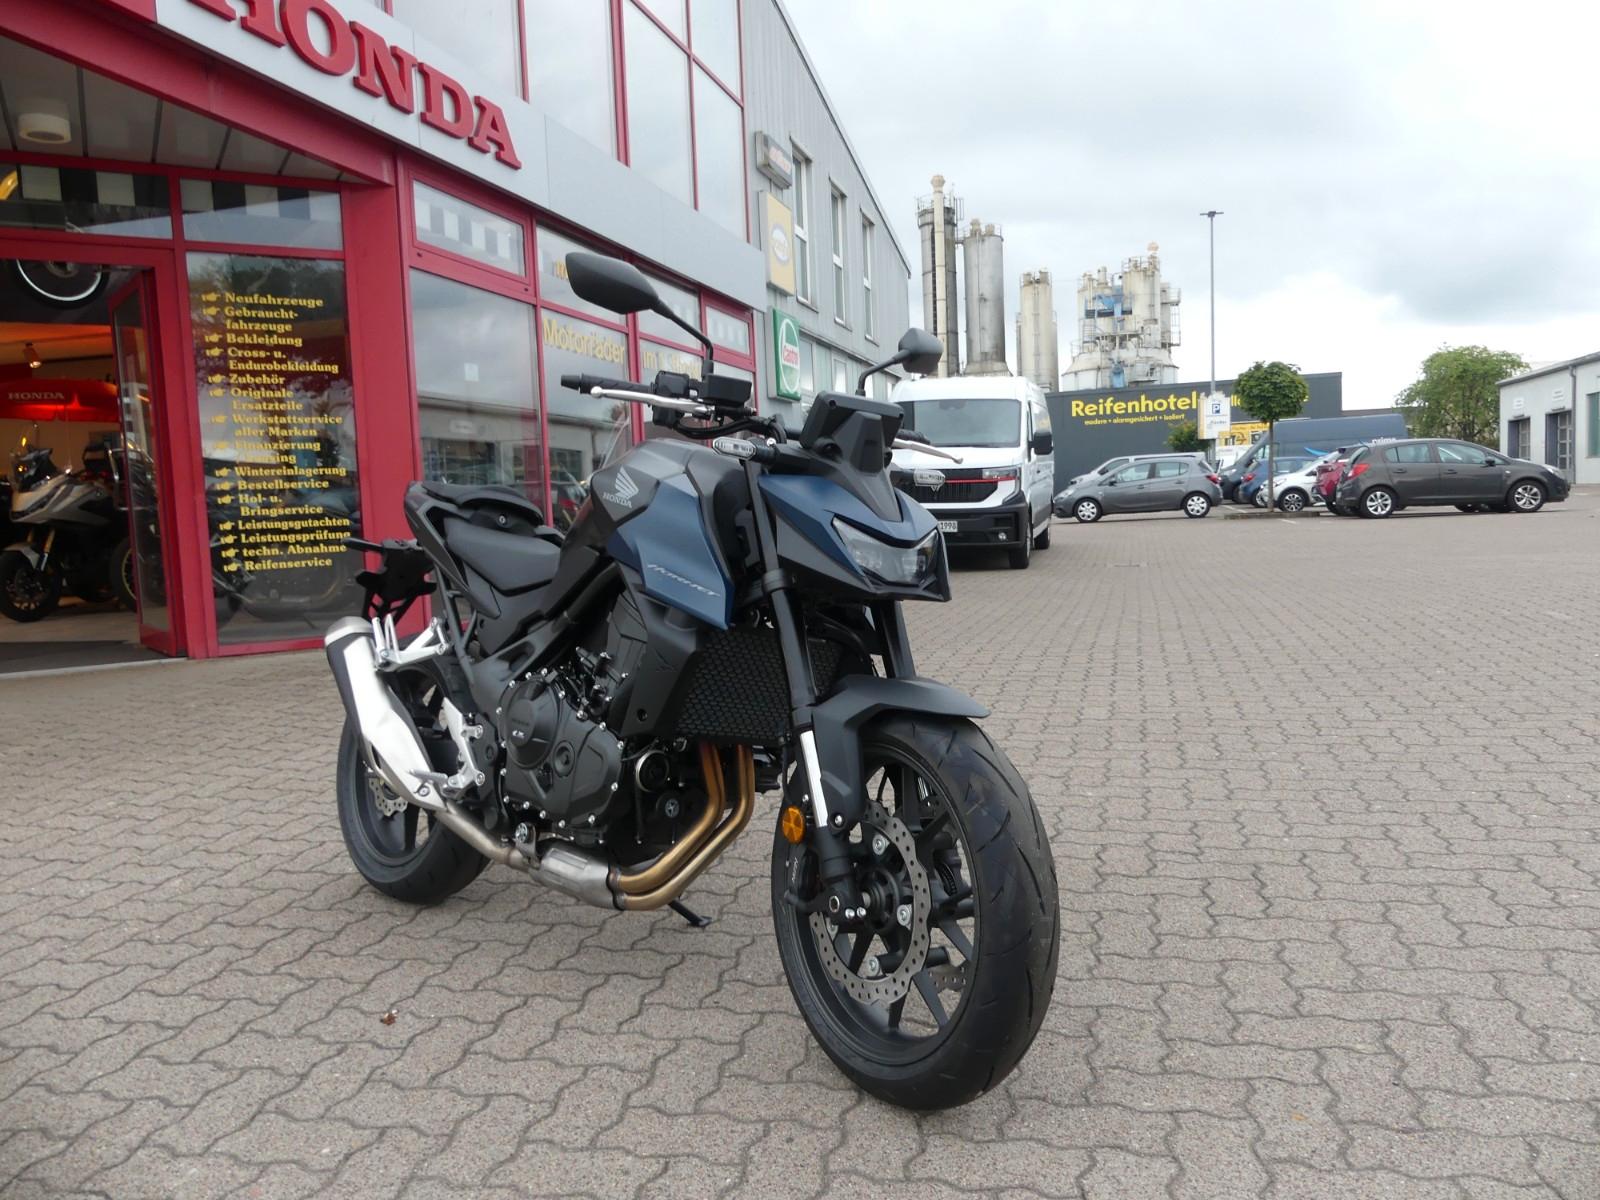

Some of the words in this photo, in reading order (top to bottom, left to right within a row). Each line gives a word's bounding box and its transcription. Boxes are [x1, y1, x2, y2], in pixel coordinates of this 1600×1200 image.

[224, 292, 324, 308] Neufahrzeuge
[224, 306, 298, 319] Gebraucht-
[226, 319, 293, 333] fahrzeuge
[226, 333, 303, 347] Bekleidung
[542, 319, 625, 366] Motorräder
[227, 347, 270, 358] Cross-
[273, 350, 287, 359] u.
[229, 360, 339, 374] Endurobekleidung
[229, 373, 286, 385] Zubehör
[8, 391, 65, 400] HONDA
[230, 387, 294, 399] Originale
[232, 400, 304, 411] Ersatzteile
[1071, 390, 1197, 417] Reifenhotel
[232, 413, 343, 425] Werkstattservice
[234, 426, 265, 437] aller
[268, 426, 318, 437] Marken
[234, 466, 347, 477] Wintereinlagerung
[237, 479, 330, 491] Bestellservice
[238, 493, 267, 504] Hol-
[269, 495, 283, 503] u.
[601, 491, 633, 509] HONDA
[240, 505, 324, 517] Bringservice
[238, 517, 351, 531] Leistungsgutachten
[240, 531, 351, 544] Leistungsprüfung
[242, 547, 284, 558] techn.
[287, 543, 347, 555] Abnahme
[244, 557, 333, 572] Reifenservice
